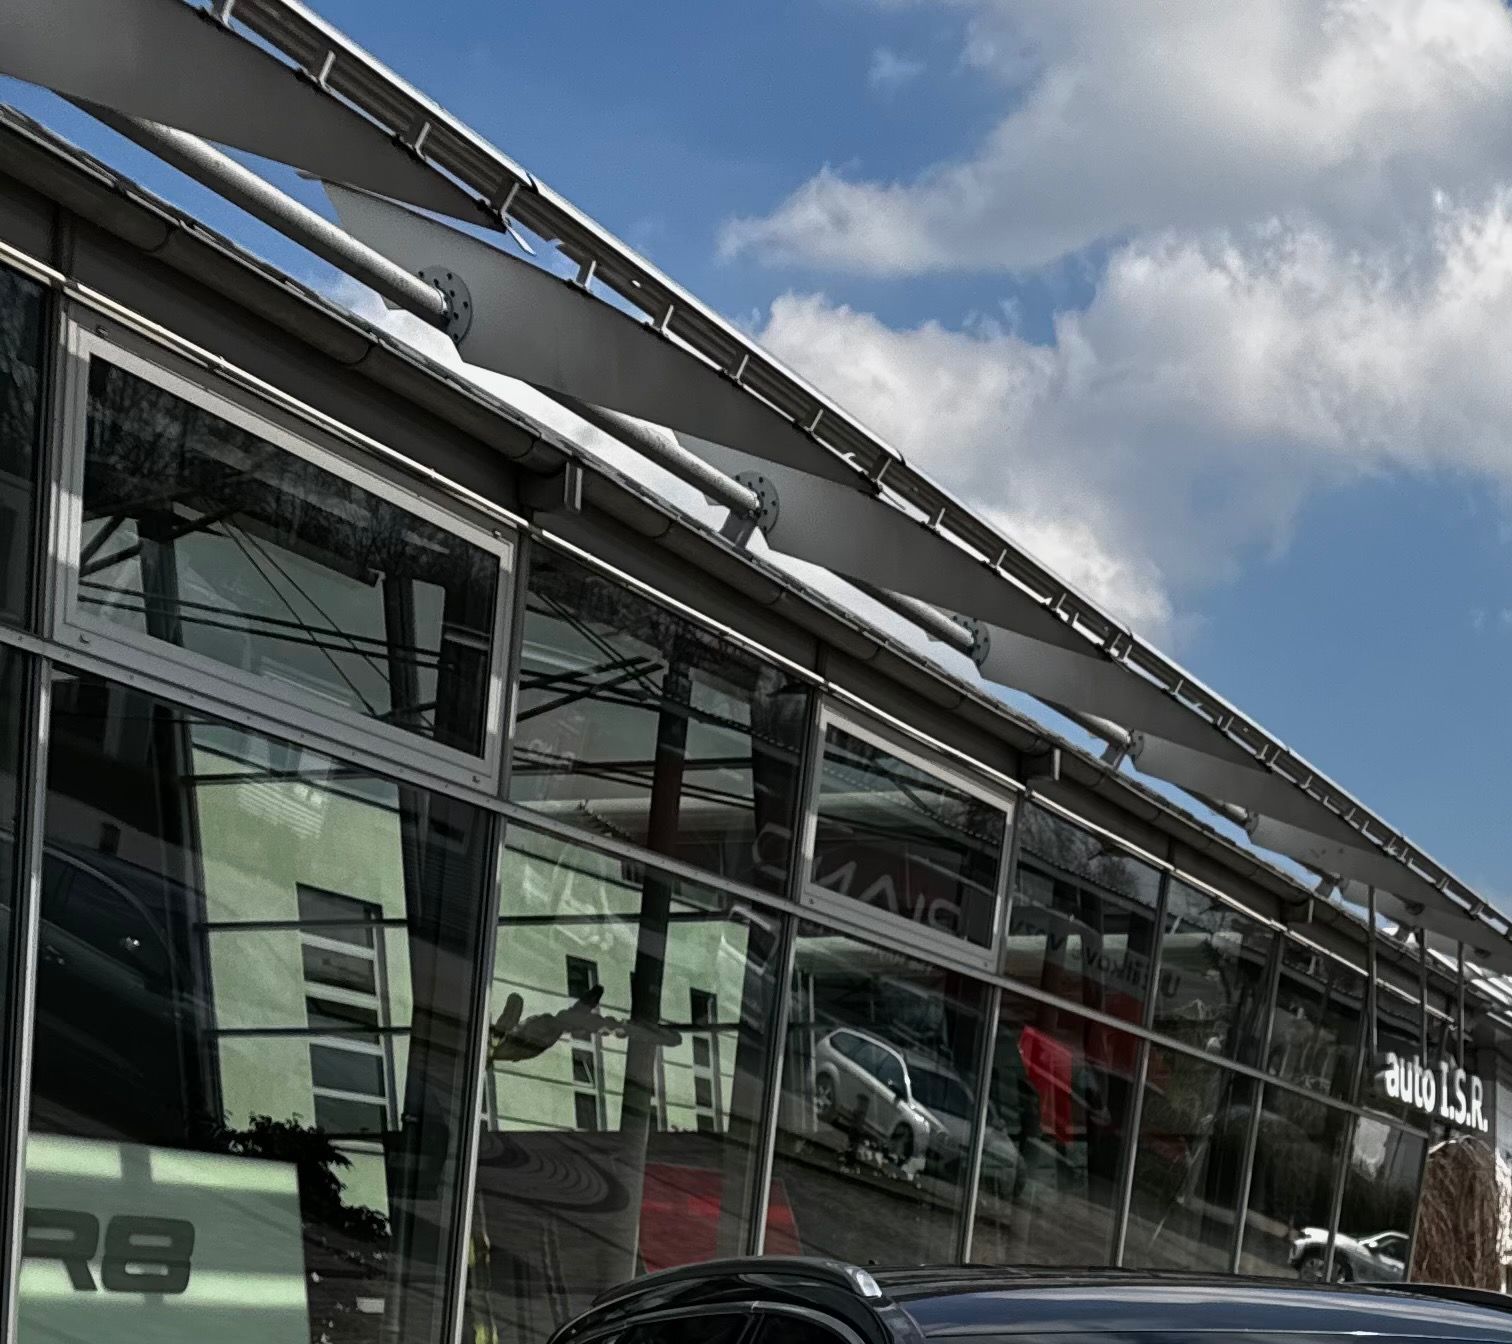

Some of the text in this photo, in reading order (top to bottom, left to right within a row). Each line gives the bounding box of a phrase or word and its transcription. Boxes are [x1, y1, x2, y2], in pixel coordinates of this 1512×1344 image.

[1385, 1051, 1489, 1133] auto I.S.R.
[21, 1206, 196, 1295] R8
